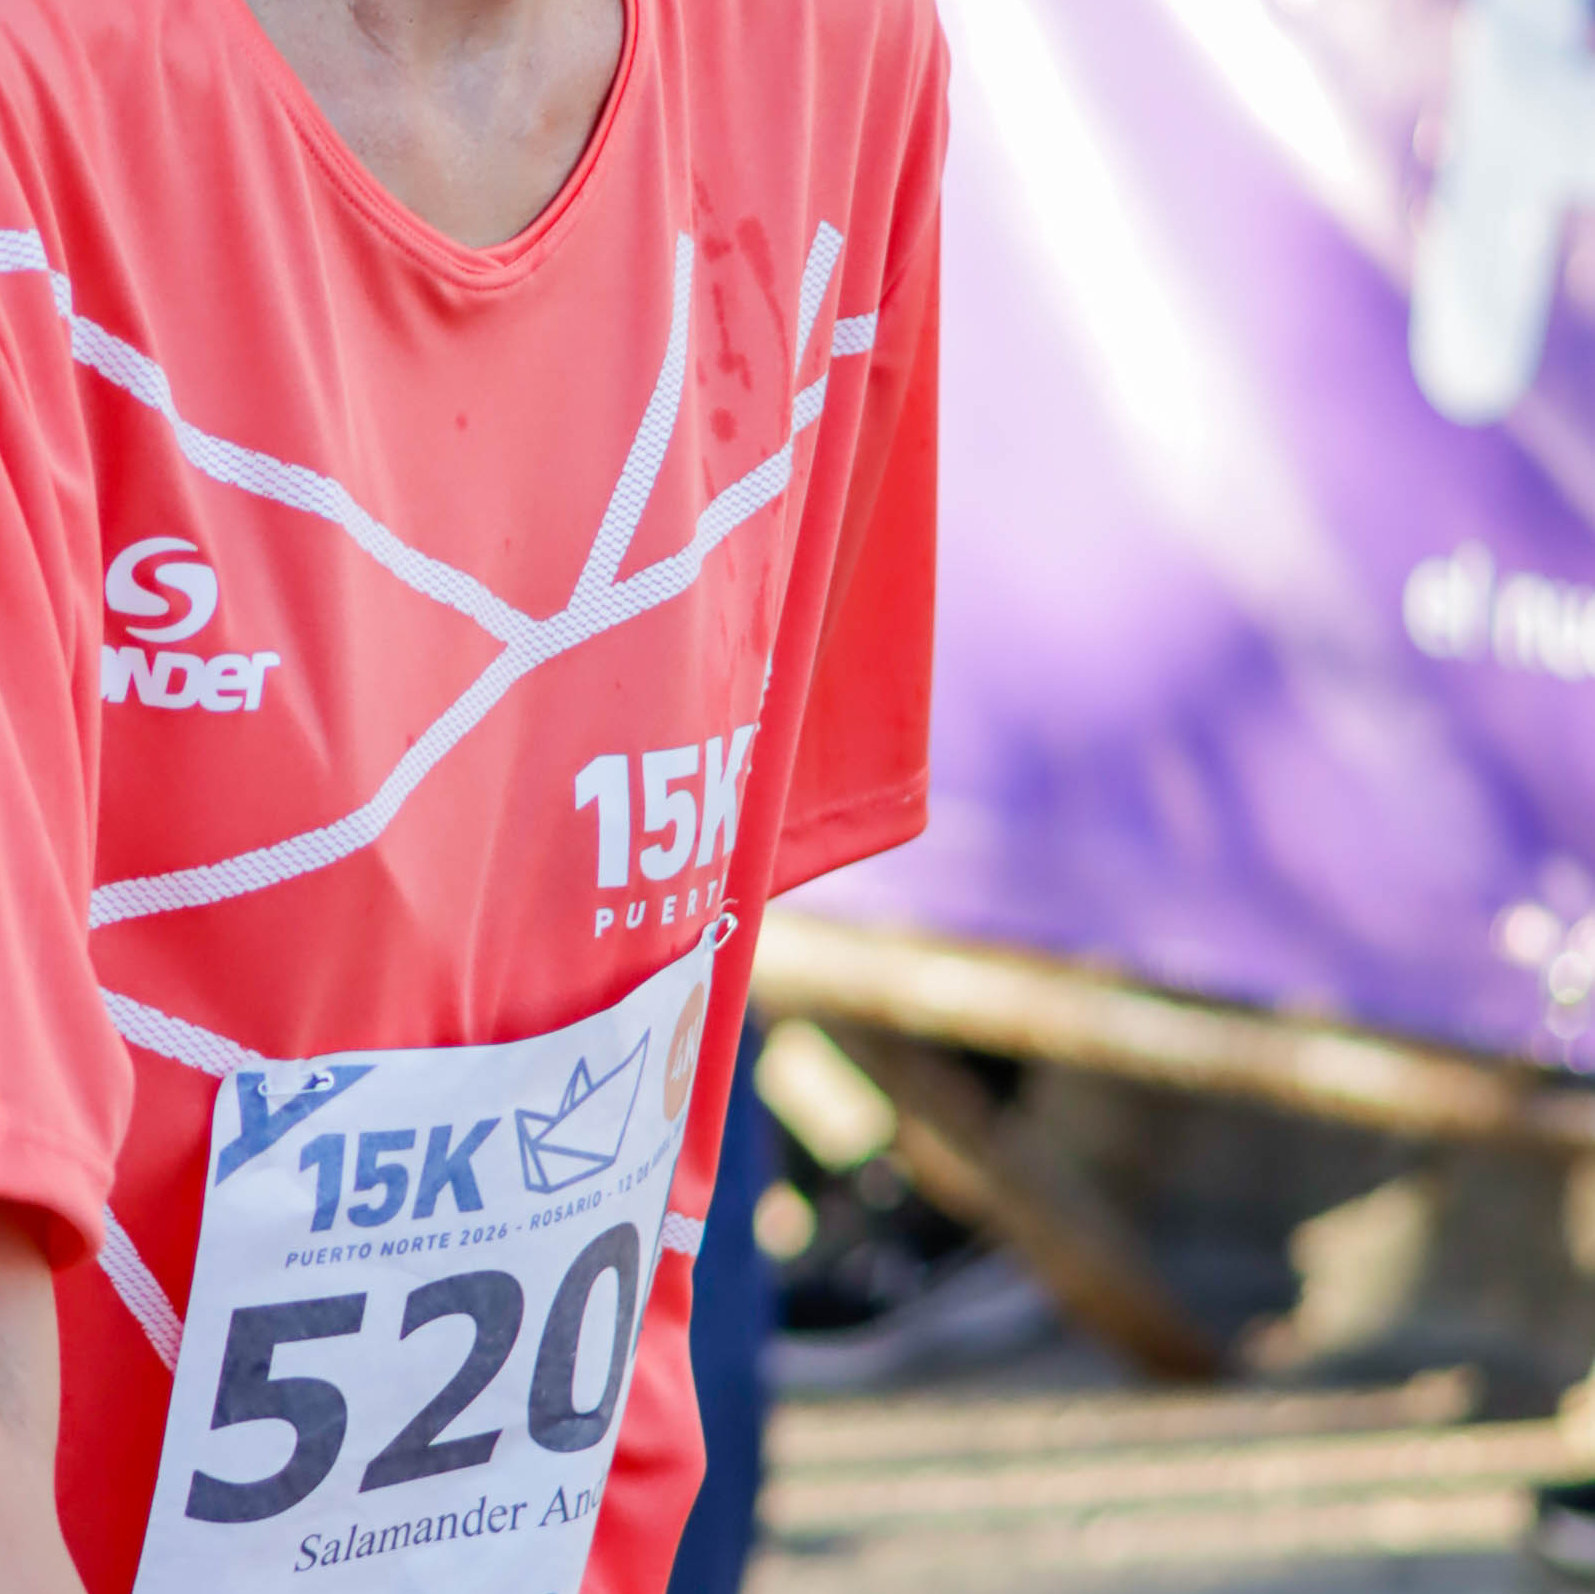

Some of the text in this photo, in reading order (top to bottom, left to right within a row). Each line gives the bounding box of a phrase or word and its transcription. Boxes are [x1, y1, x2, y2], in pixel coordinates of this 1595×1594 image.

[575, 723, 756, 889] 15K
[594, 871, 727, 939] PUERT
[299, 1117, 502, 1234] 15K
[285, 1241, 373, 1269] PUERTO
[381, 1232, 452, 1258] NORTE
[459, 1223, 509, 1248] 2026
[530, 1190, 602, 1231] ROSARIO
[185, 1222, 640, 1524] 520
[293, 1496, 527, 1573] Salamander
